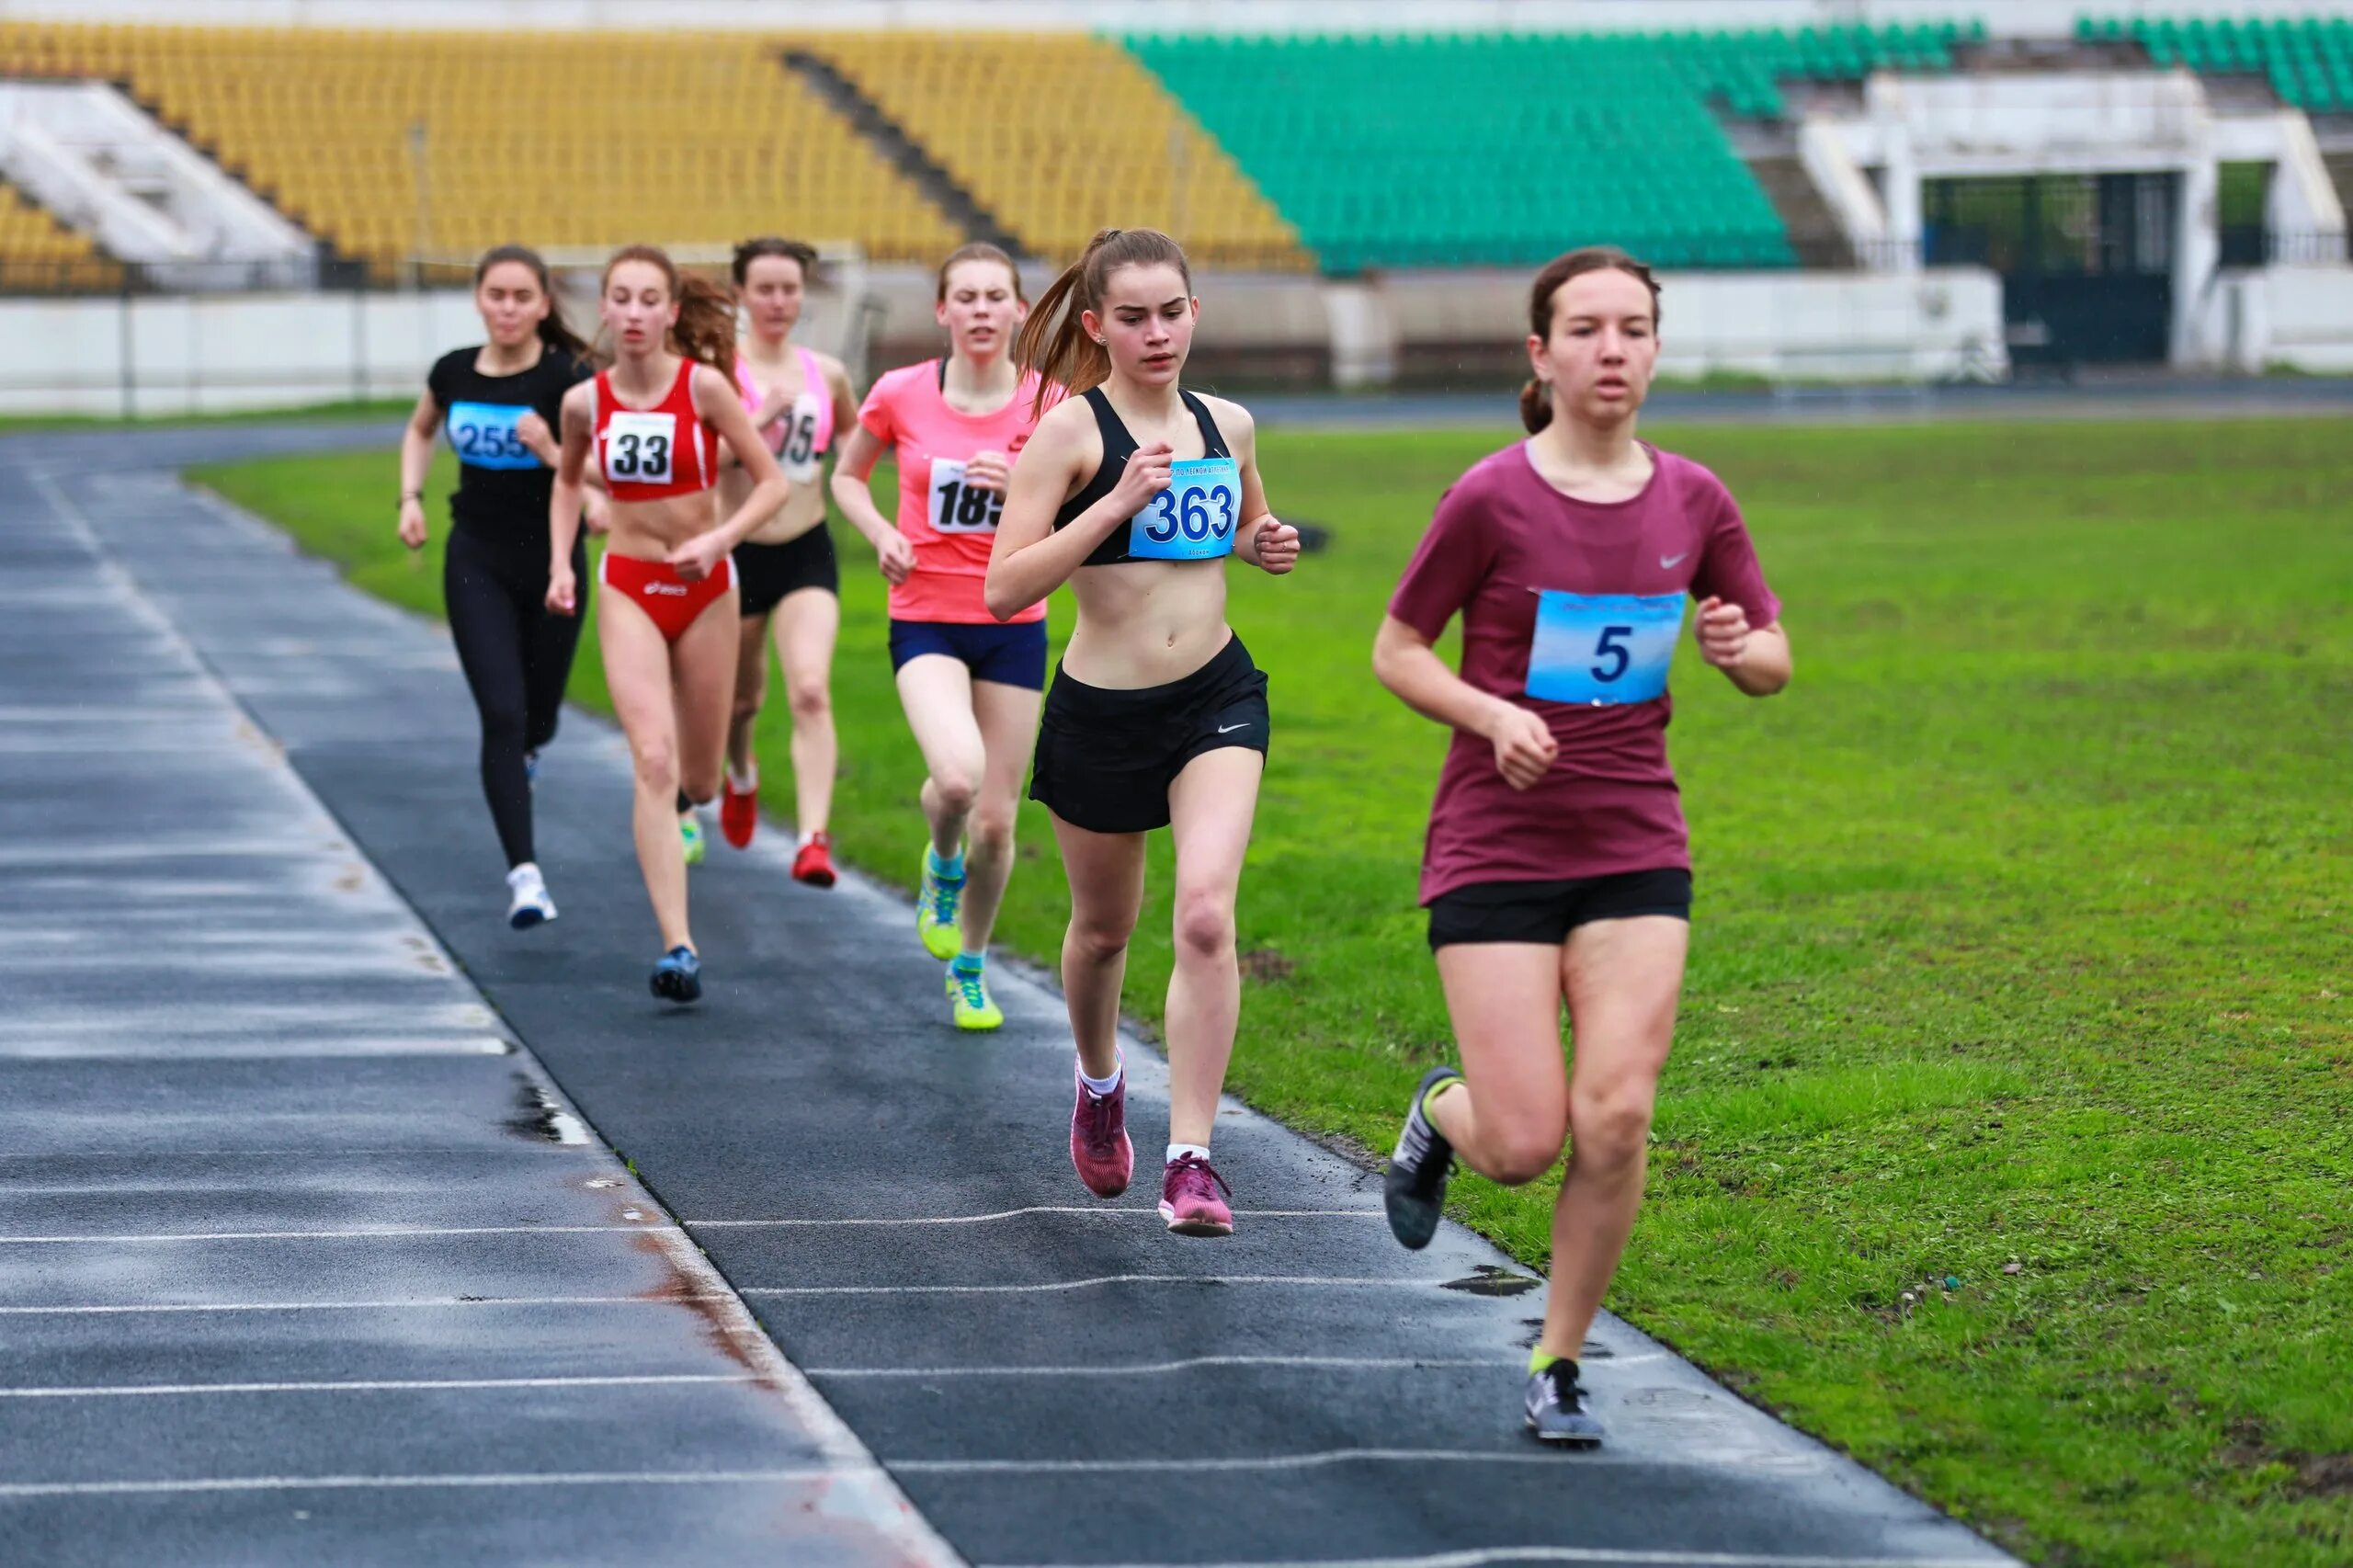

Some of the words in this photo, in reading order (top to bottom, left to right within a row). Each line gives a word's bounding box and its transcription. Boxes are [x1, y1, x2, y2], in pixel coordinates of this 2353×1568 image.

[460, 425, 528, 459] 255
[614, 434, 668, 476] 33
[1144, 483, 1233, 543] 363
[1590, 626, 1632, 683] 5
